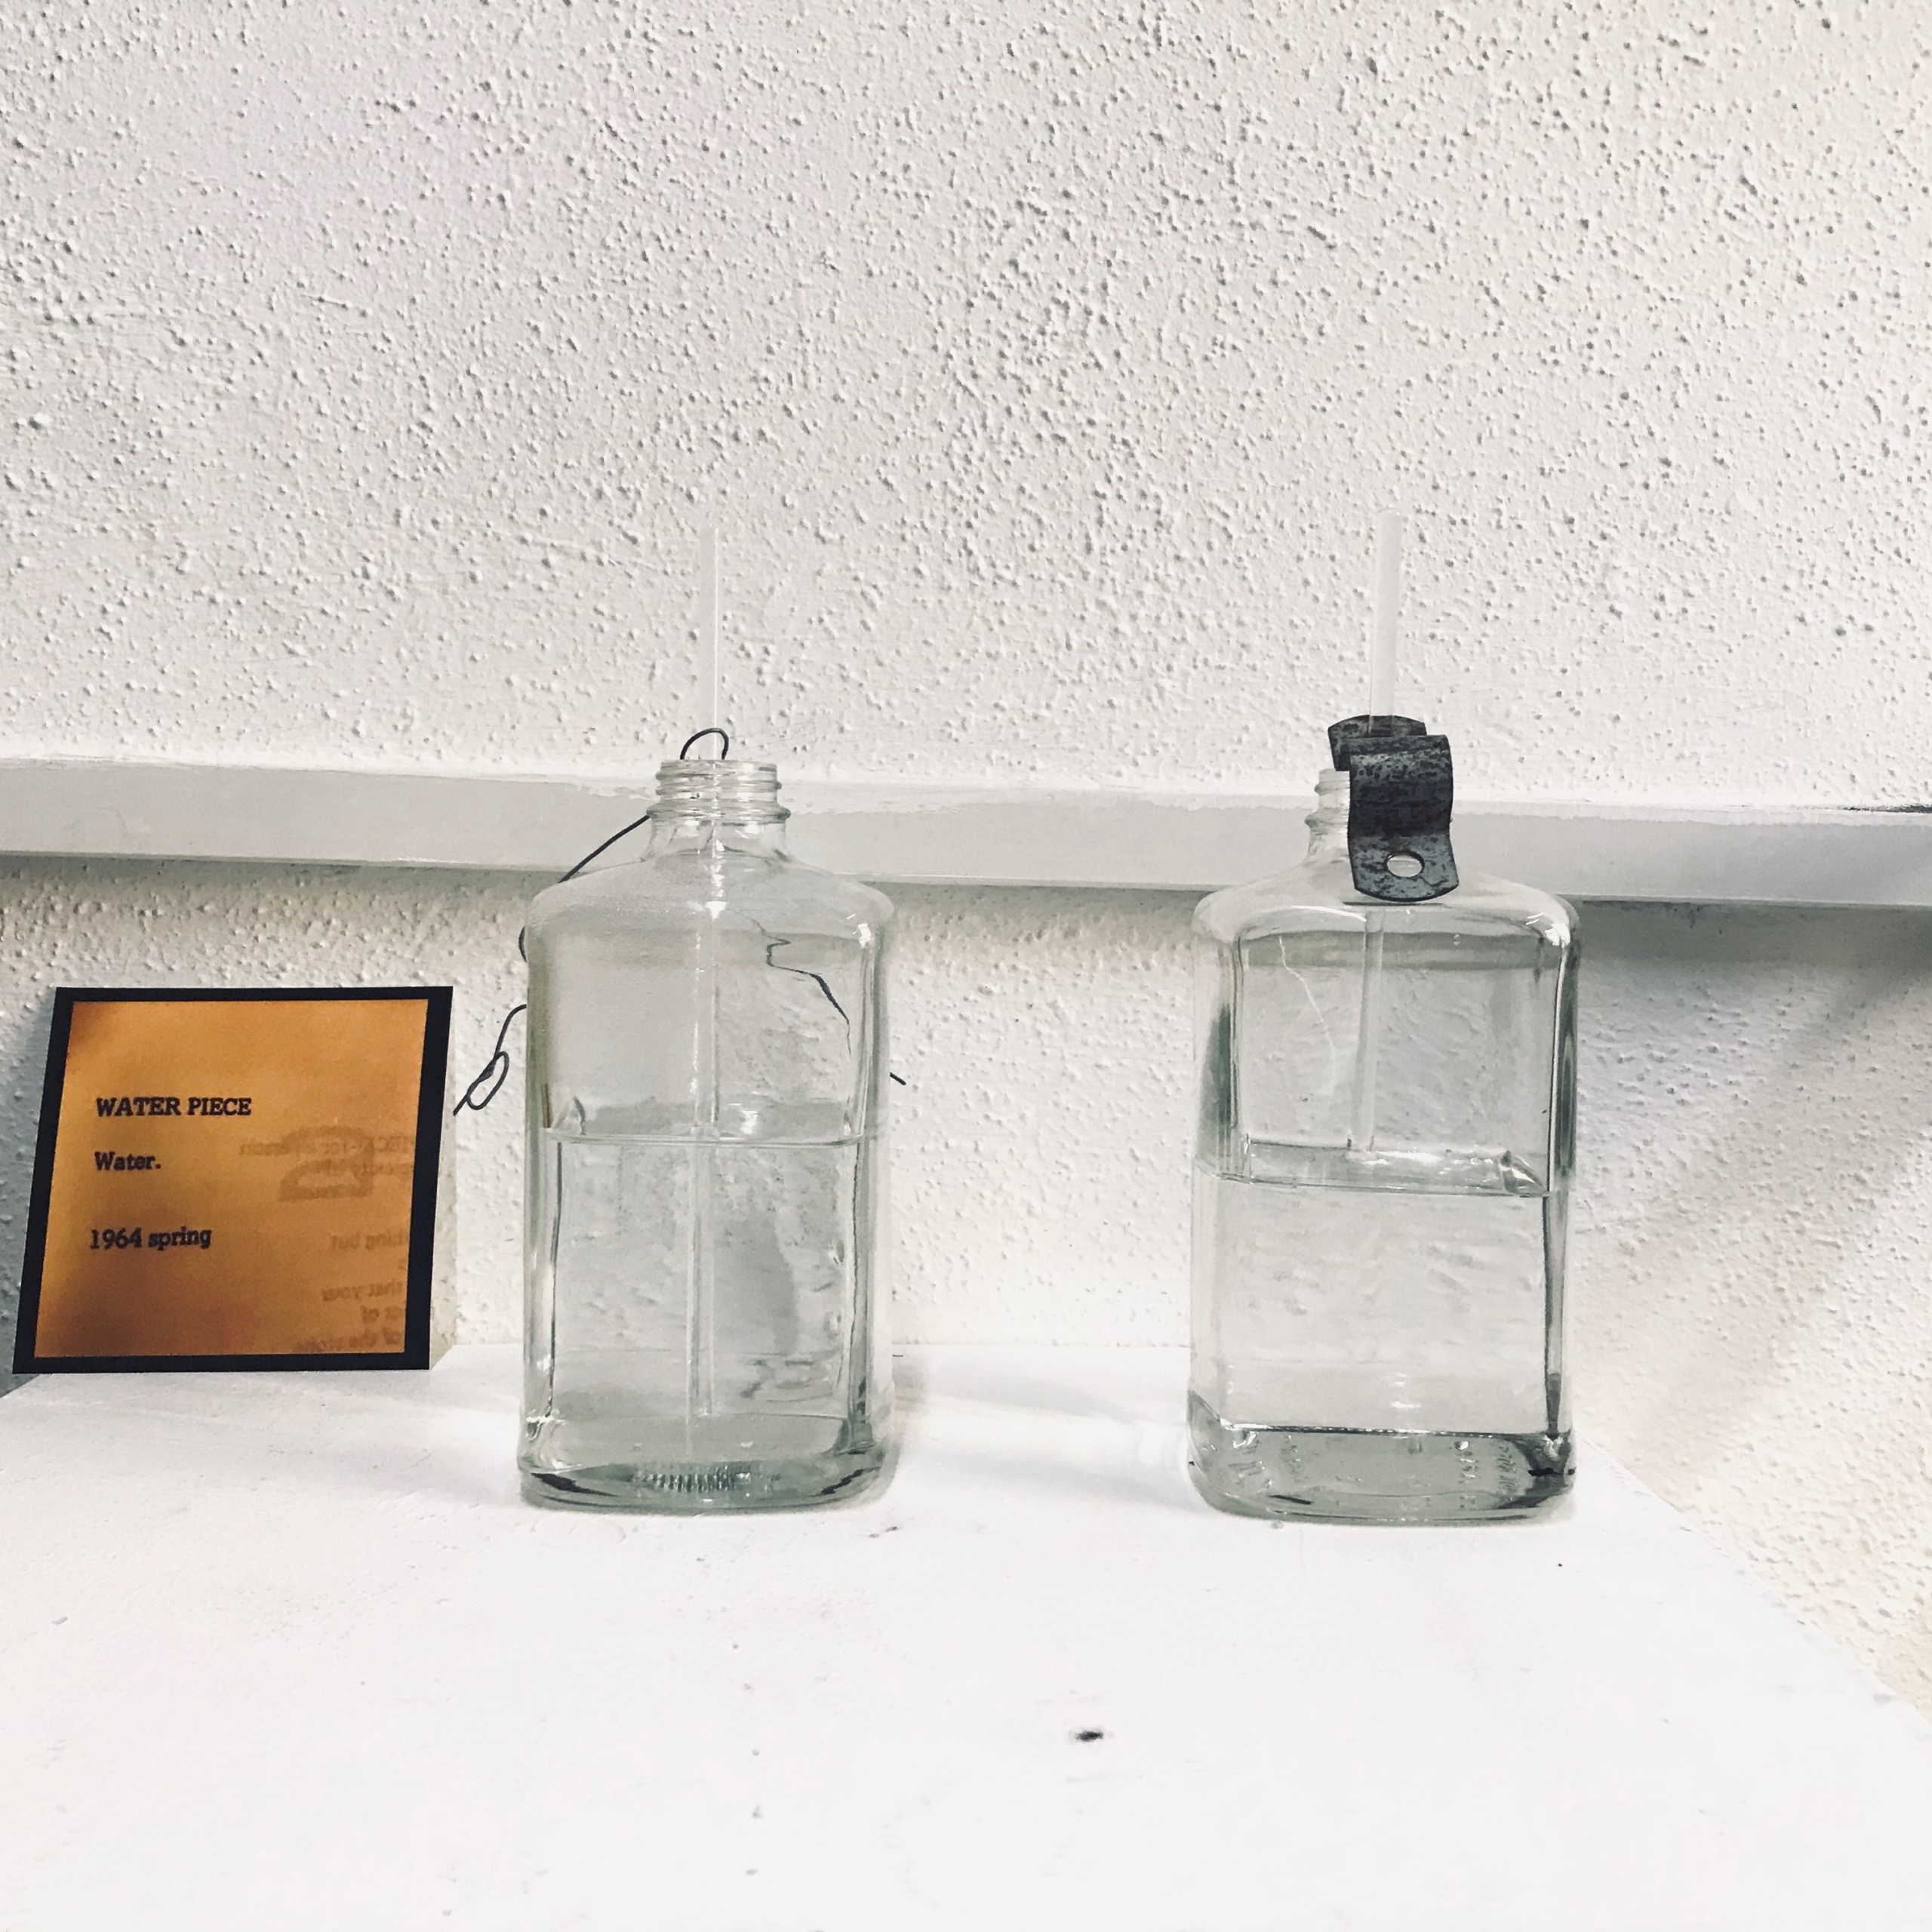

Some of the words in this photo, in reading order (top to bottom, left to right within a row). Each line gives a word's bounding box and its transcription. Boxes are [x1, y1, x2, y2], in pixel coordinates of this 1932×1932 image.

[96, 1097, 181, 1117] WATER
[187, 1097, 252, 1116] PIECE
[94, 1151, 162, 1171] Water.
[90, 1227, 143, 1249] 1964
[147, 1226, 212, 1251] spring
